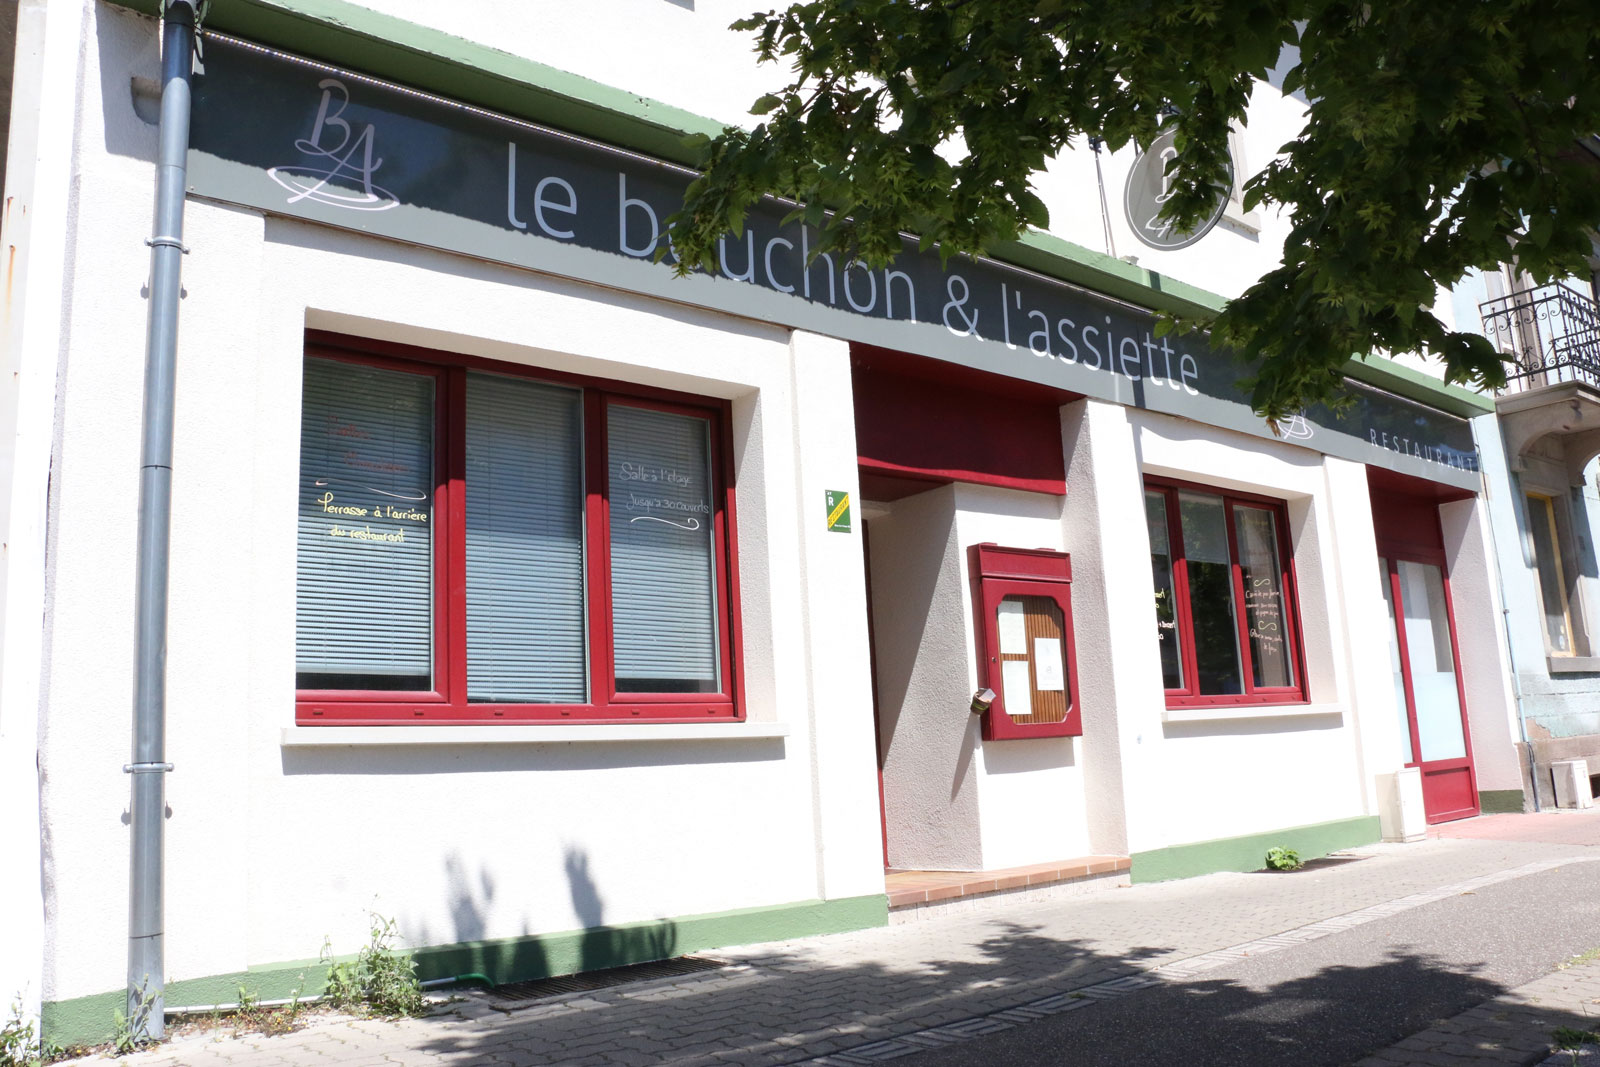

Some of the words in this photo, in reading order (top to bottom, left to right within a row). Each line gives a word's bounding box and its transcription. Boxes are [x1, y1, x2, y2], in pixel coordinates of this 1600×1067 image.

[507, 142, 578, 240] le
[942, 275, 985, 342] &
[1001, 282, 1200, 396] l'assiette
[1370, 428, 1474, 475] RESTAURANT
[317, 491, 368, 517] Terrasse
[373, 505, 383, 518] à
[330, 524, 346, 537] du
[350, 525, 405, 543] restaurant
